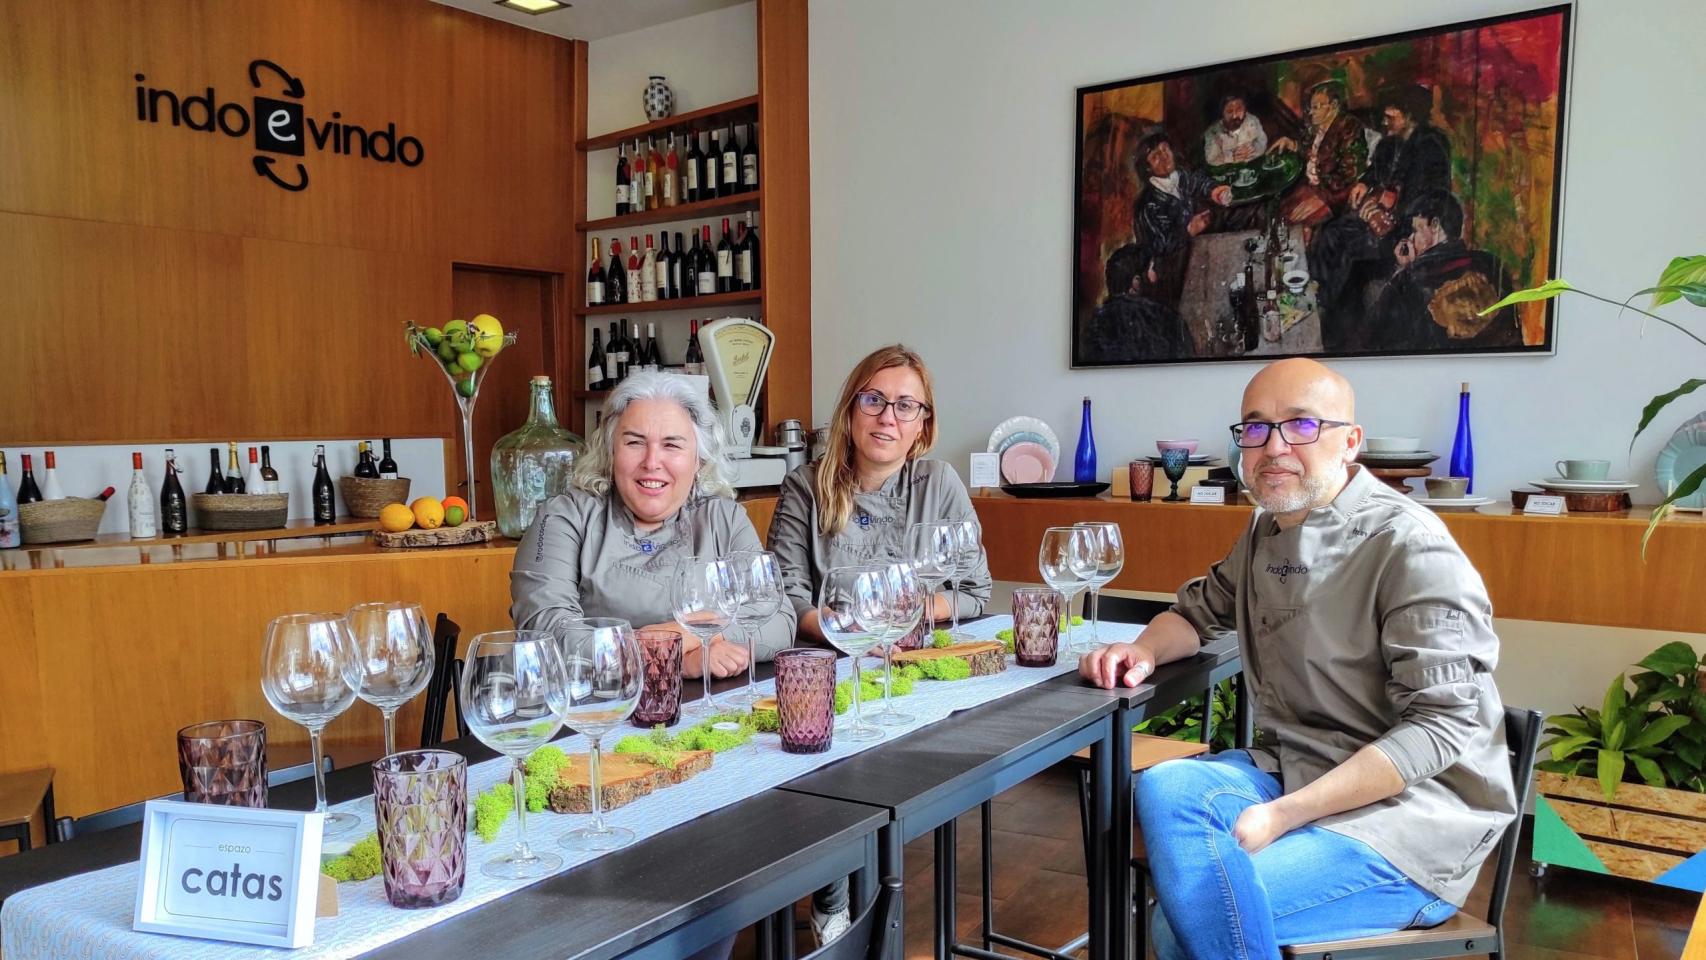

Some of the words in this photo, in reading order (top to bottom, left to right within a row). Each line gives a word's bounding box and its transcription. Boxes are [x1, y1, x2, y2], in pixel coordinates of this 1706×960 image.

[134, 73, 251, 138] indo
[306, 111, 425, 168] vindo
[218, 842, 251, 855] espazo
[181, 862, 284, 902] catas
